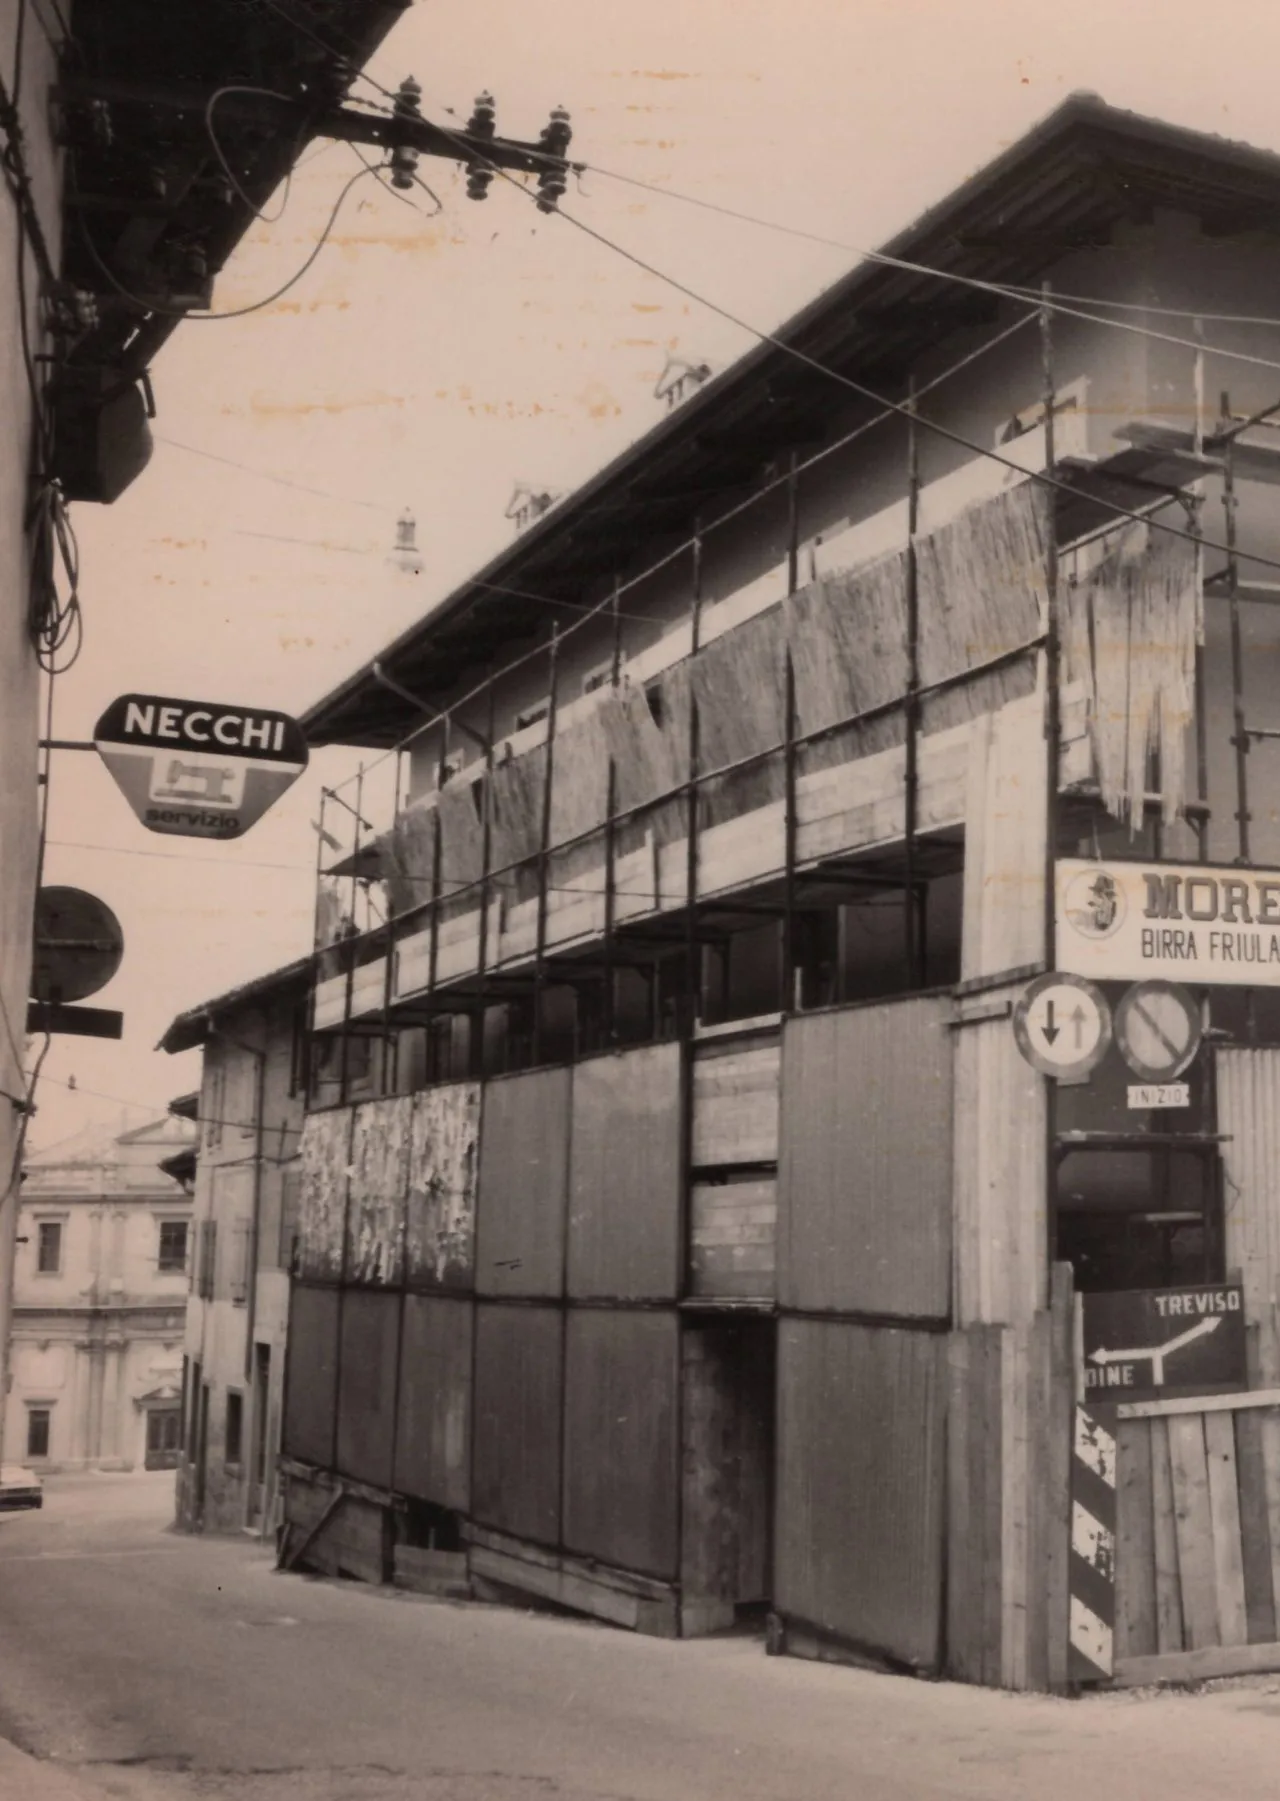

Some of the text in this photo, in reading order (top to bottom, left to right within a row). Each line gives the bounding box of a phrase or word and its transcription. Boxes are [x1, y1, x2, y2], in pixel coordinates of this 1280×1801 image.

[124, 702, 285, 751] NECCHI
[145, 808, 240, 830] servizio
[1141, 928, 1198, 960] BIRRA
[1133, 1087, 1183, 1104] INIZIO
[1155, 1290, 1240, 1317] TREVISO
[1084, 1365, 1135, 1388] DINE
